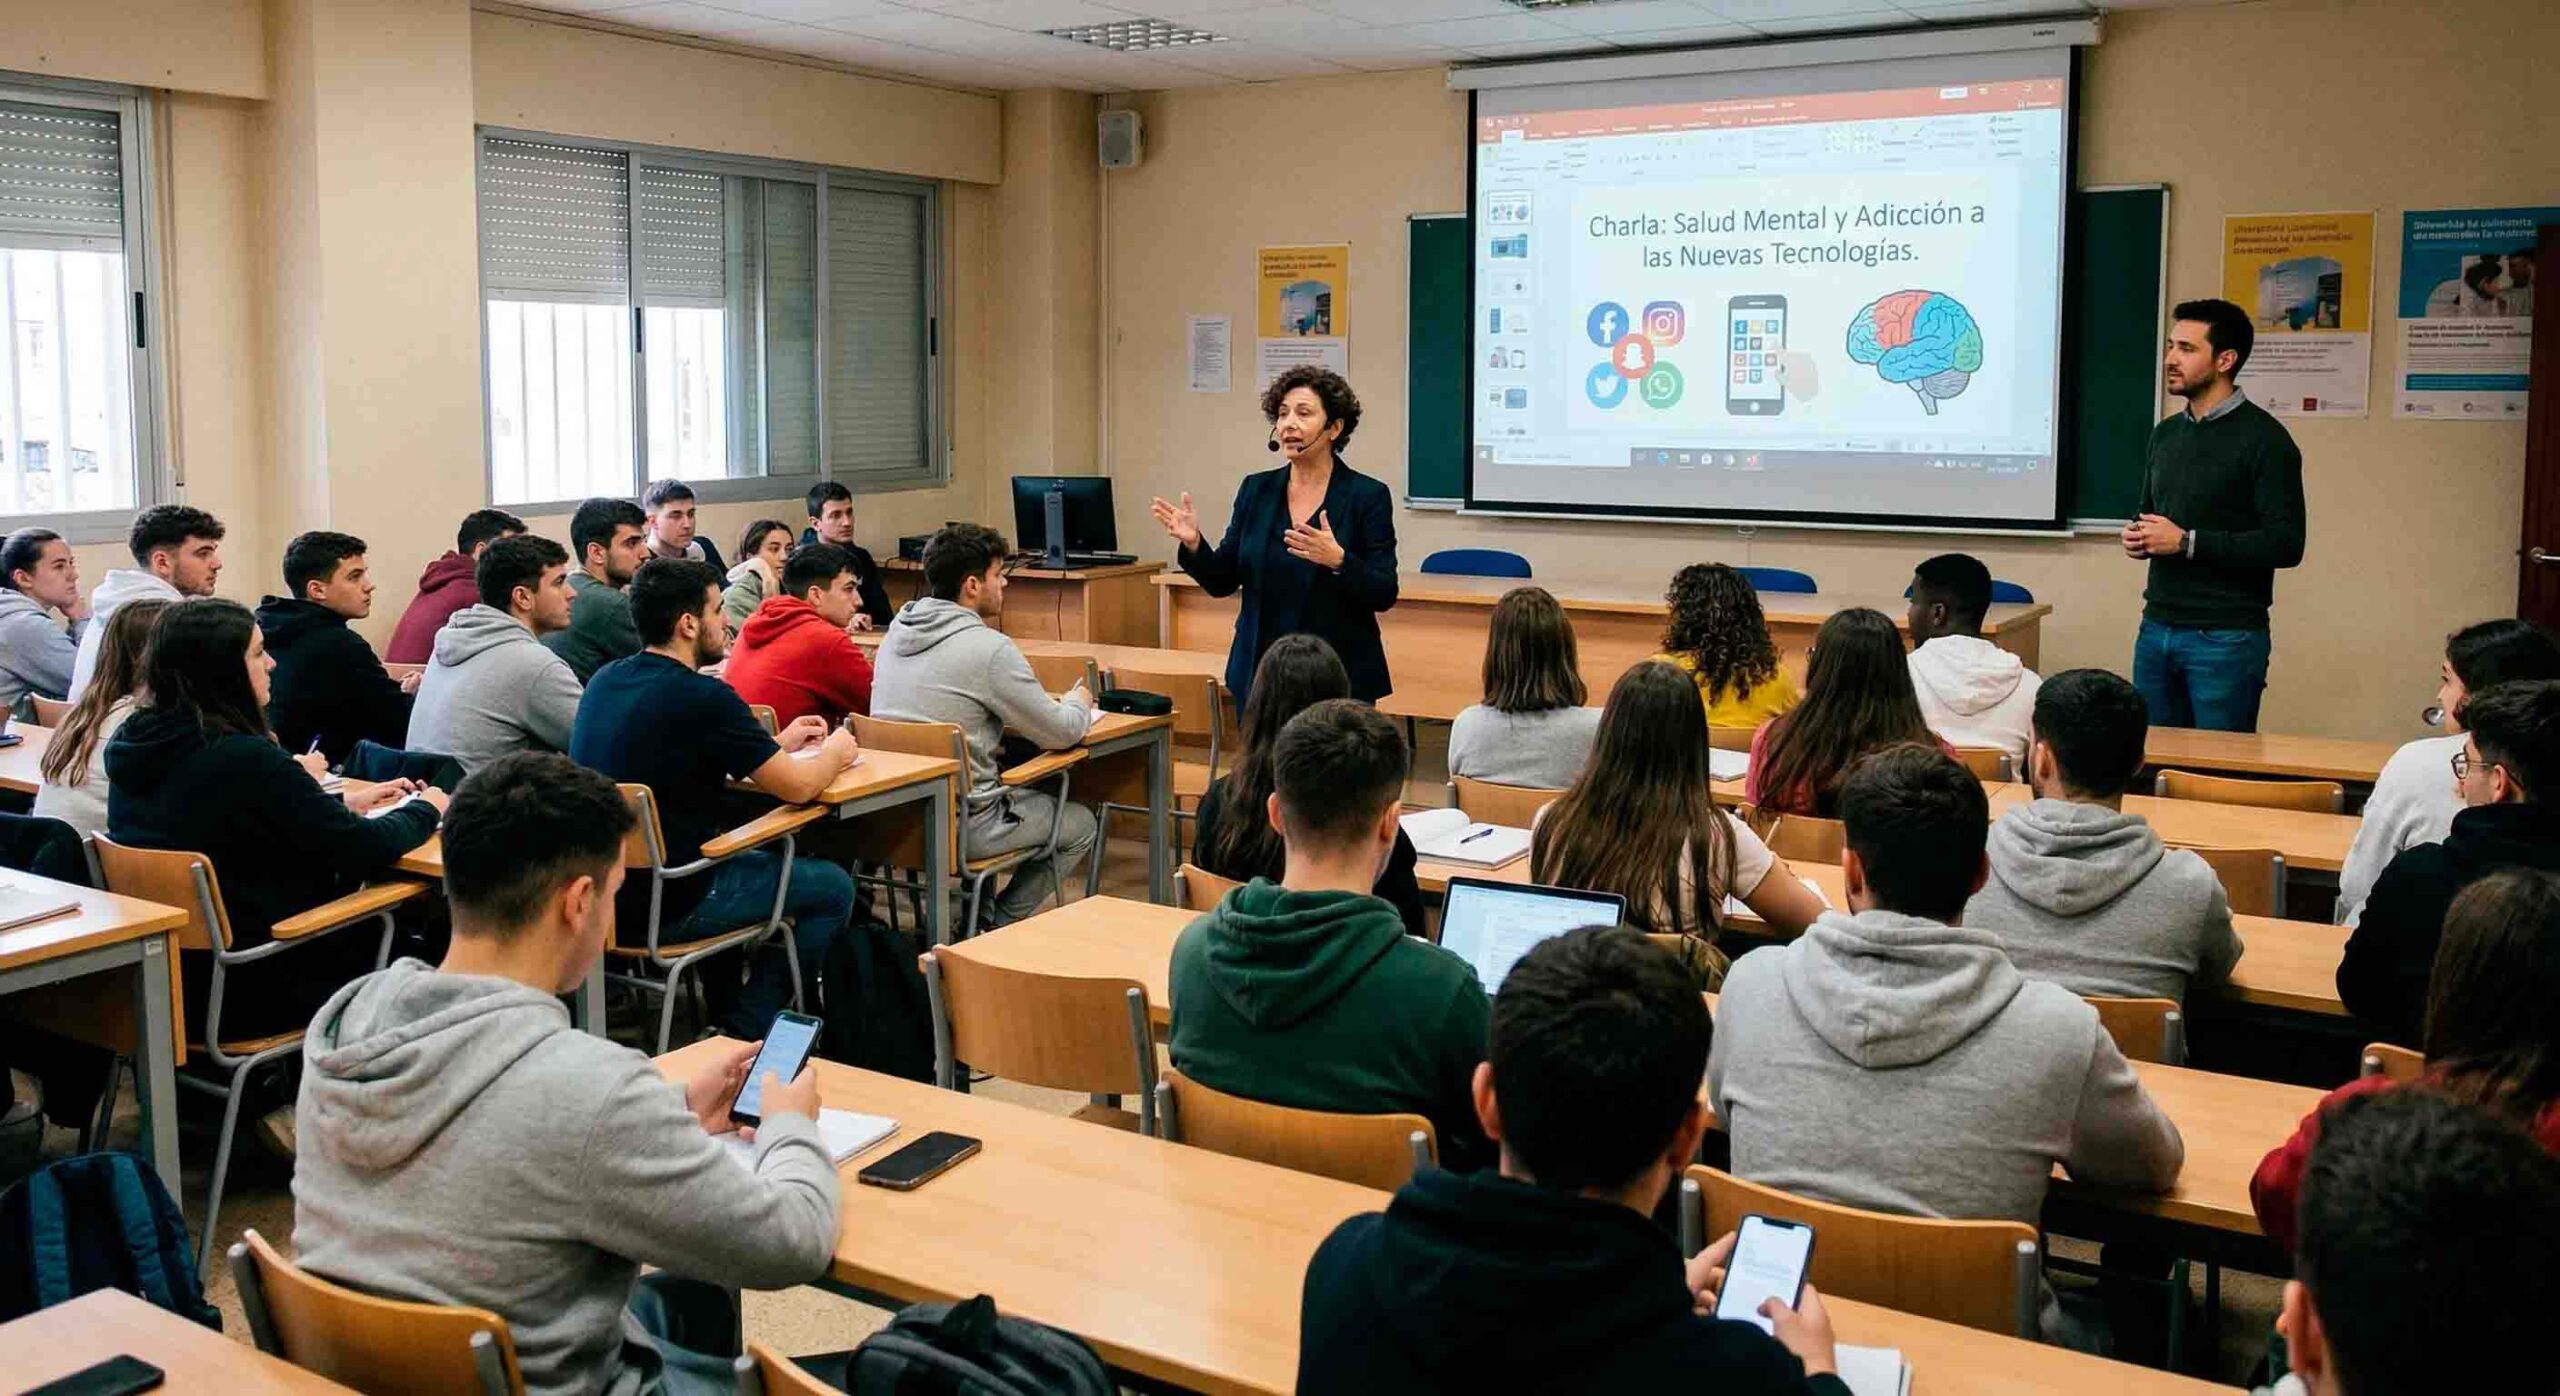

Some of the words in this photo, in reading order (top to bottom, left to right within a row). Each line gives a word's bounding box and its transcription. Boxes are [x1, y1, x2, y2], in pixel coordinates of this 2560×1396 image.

[1589, 213, 1667, 238] Charla:
[1674, 209, 1736, 234] Salud
[1744, 204, 1827, 232] Mental
[1835, 210, 1848, 233] y
[1854, 199, 1963, 228] Adicción
[1970, 204, 1985, 224] a
[1642, 245, 1673, 268] las
[1680, 244, 1764, 267] Nuevas
[1770, 237, 1920, 268] Tecnologías.
